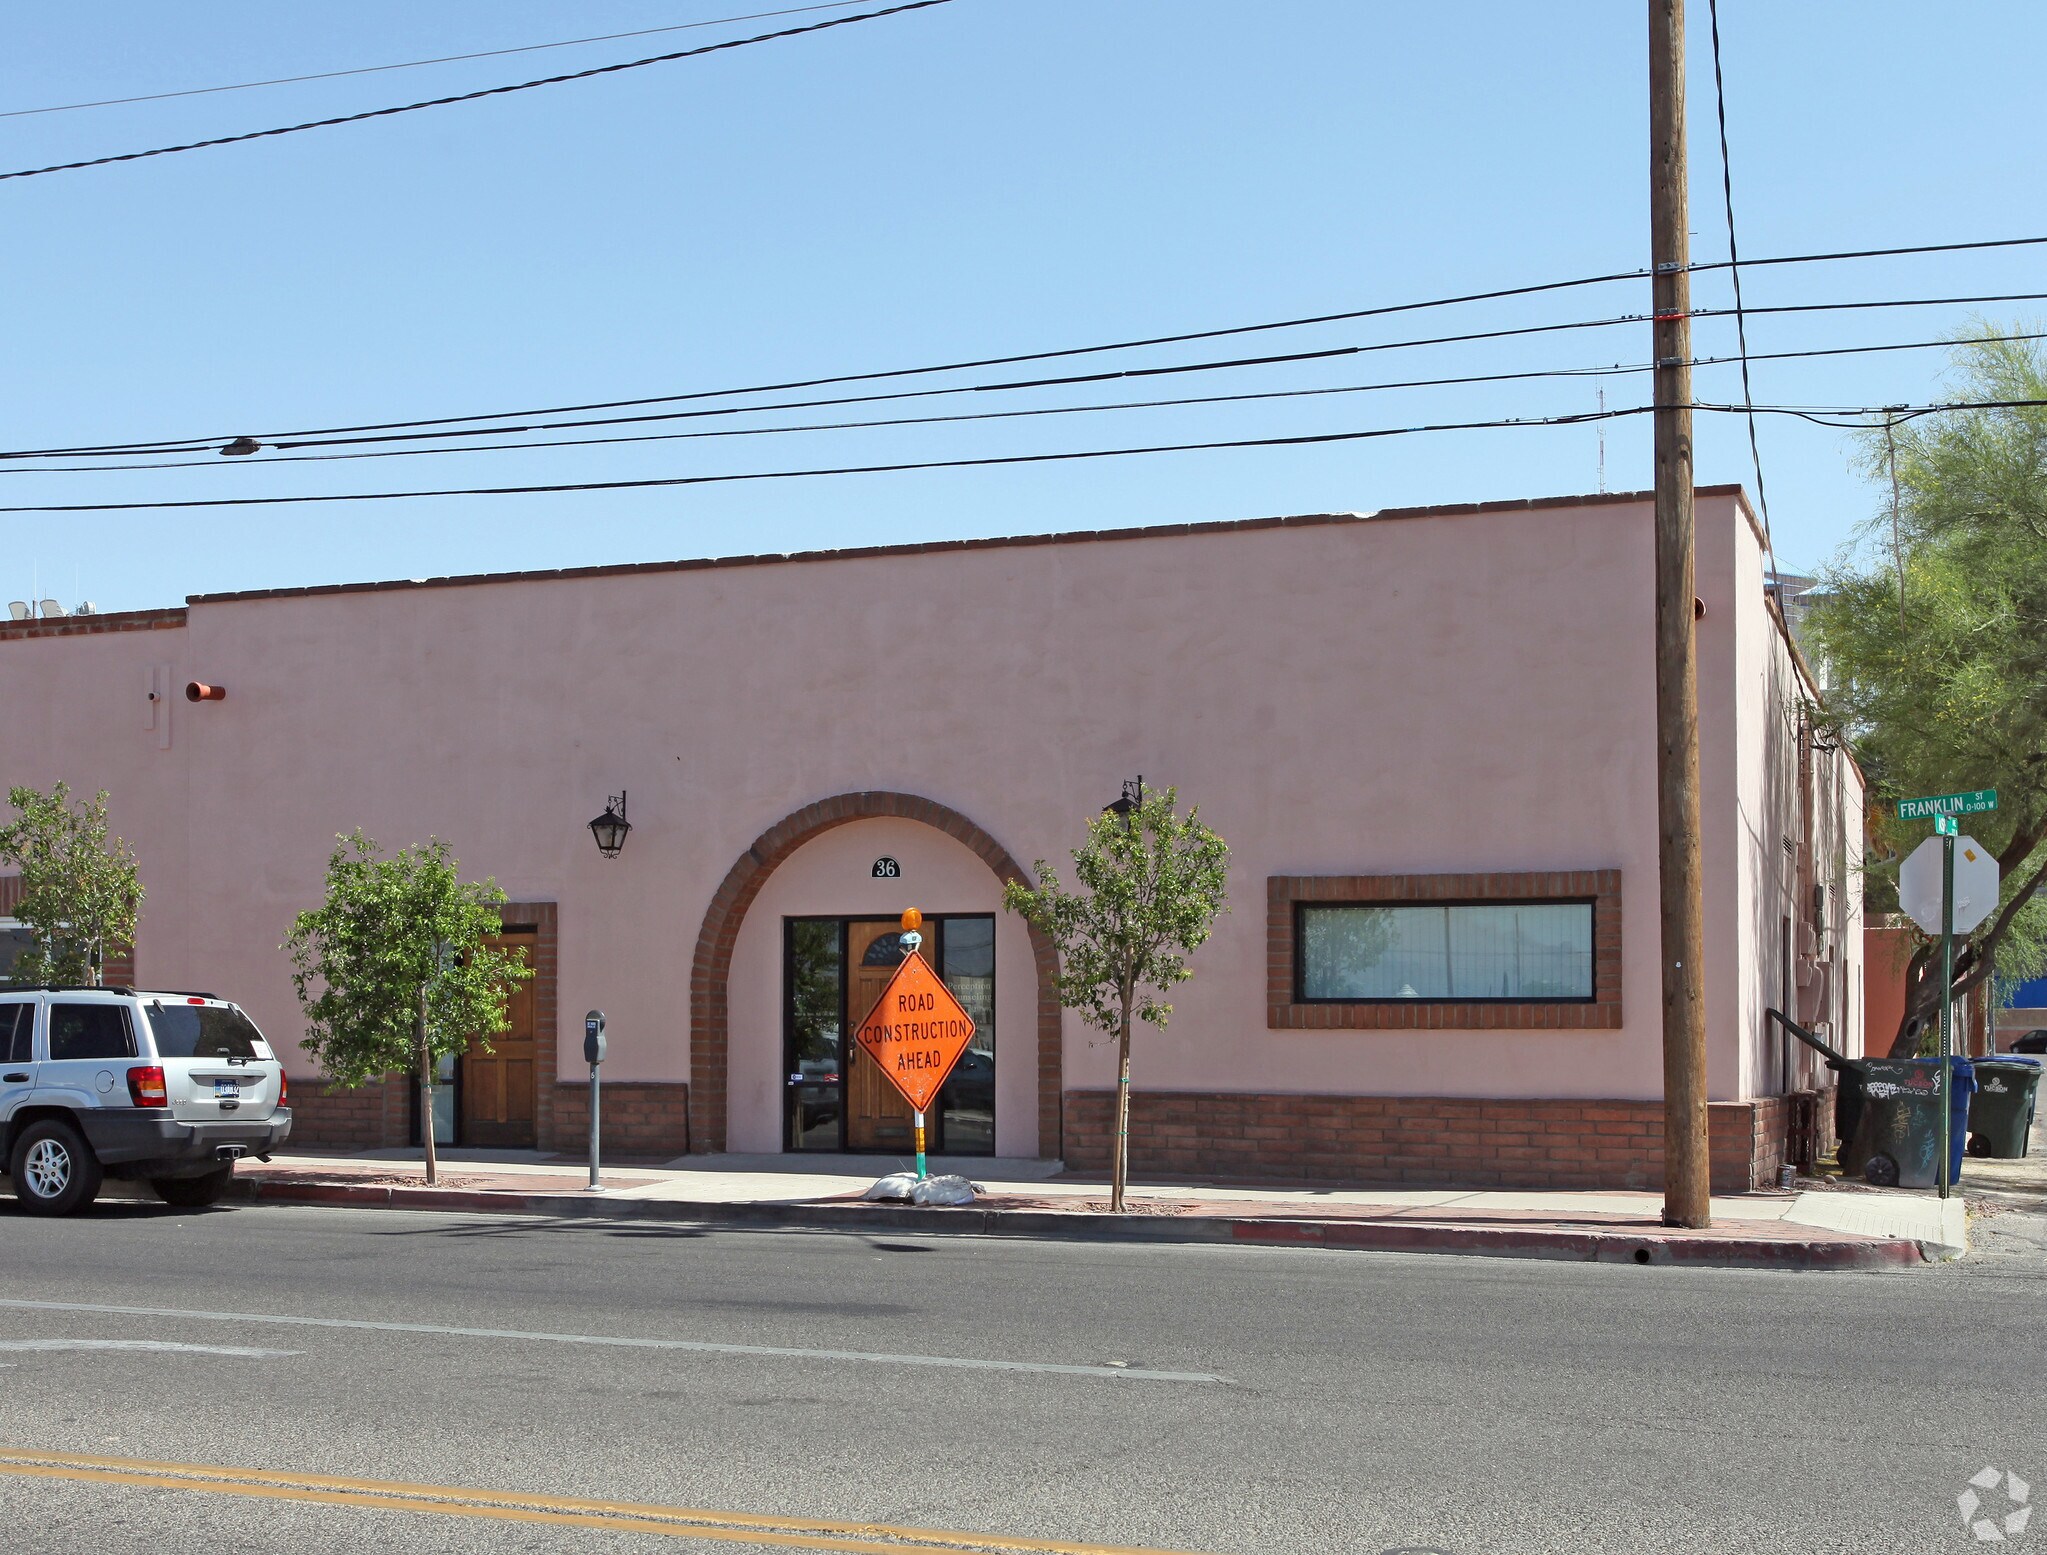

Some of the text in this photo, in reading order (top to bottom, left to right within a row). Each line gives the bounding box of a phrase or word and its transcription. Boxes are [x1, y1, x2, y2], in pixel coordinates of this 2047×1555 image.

[1900, 792, 1984, 818] FRANKLIN ST
[1966, 801, 1995, 811] 0-100 W
[876, 860, 896, 877] 36
[947, 982, 991, 991] Perception
[898, 993, 935, 1012] ROAD
[864, 1020, 967, 1044] CONSTRUCTION
[897, 1050, 941, 1071] AHEAD
[1904, 1079, 1935, 1089] TUCSON
[1983, 1084, 2008, 1093] TUCSON
